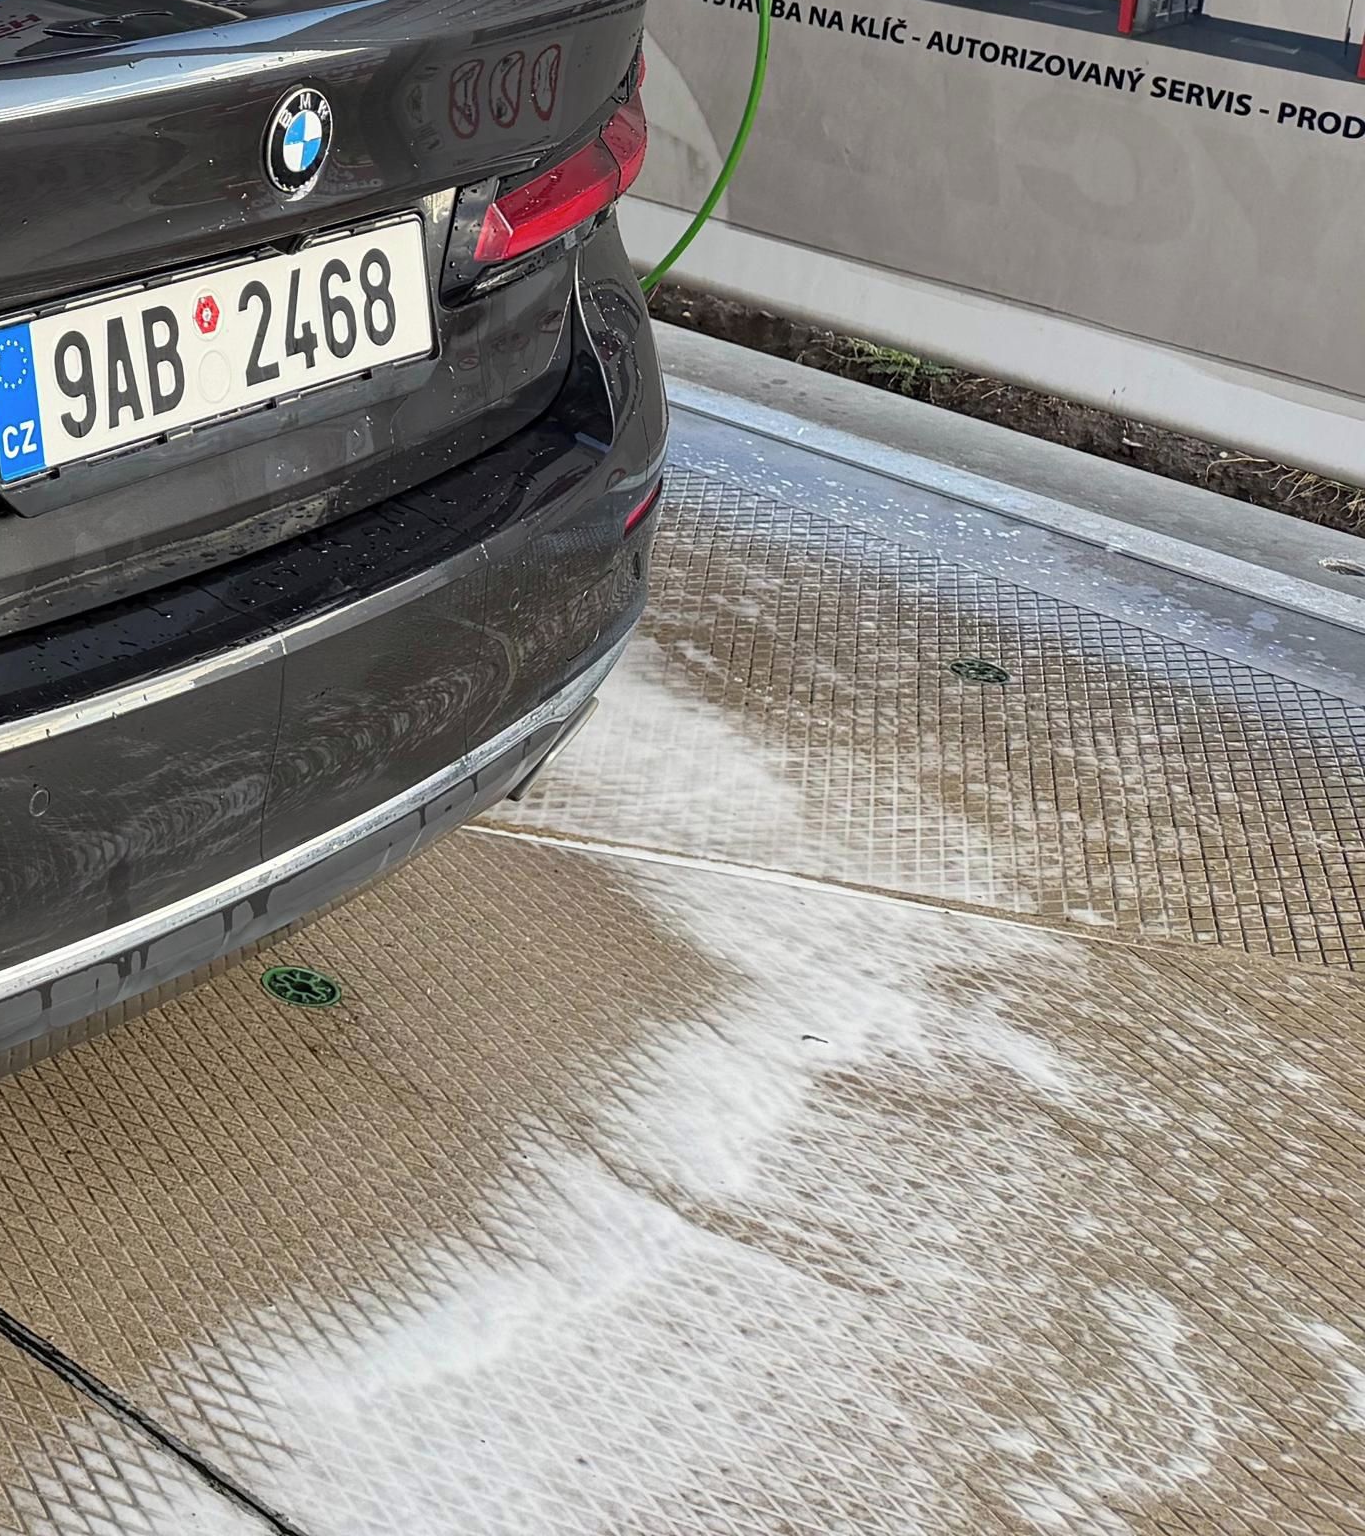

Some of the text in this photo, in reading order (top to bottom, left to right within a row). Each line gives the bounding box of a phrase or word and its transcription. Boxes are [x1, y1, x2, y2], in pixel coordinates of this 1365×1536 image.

[278, 92, 331, 129] BMW
[809, 5, 844, 32] NA
[851, 14, 908, 45] KLÍČ
[926, 30, 1146, 93] AUTORIZOVANÝ
[1150, 76, 1253, 117] SERVIS
[1277, 101, 1365, 140] PROD
[54, 248, 397, 439] 9AB 2468
[2, 421, 38, 460] CZ
